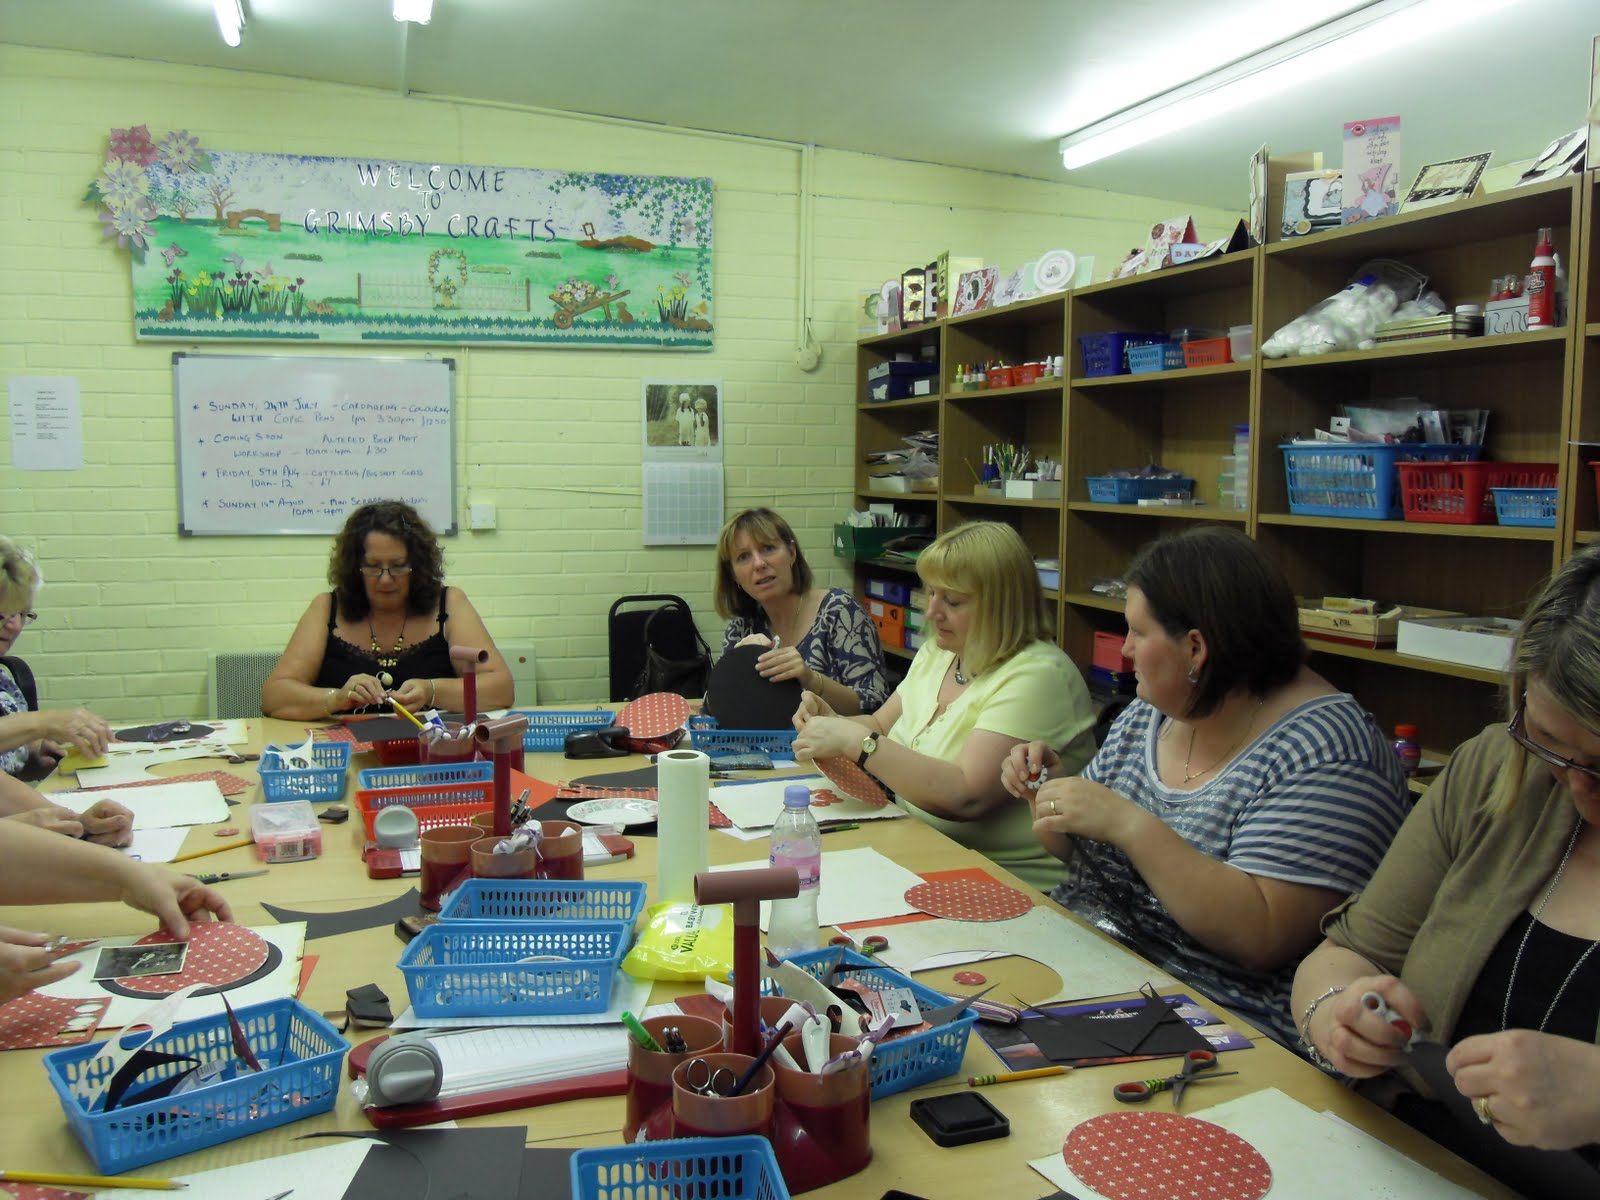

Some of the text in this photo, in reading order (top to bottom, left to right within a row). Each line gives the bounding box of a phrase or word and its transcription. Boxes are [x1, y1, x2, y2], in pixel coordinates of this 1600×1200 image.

[357, 164, 506, 193] WELCOME
[417, 190, 442, 210] TO
[304, 208, 556, 243] GRIMSBY CRAFTS
